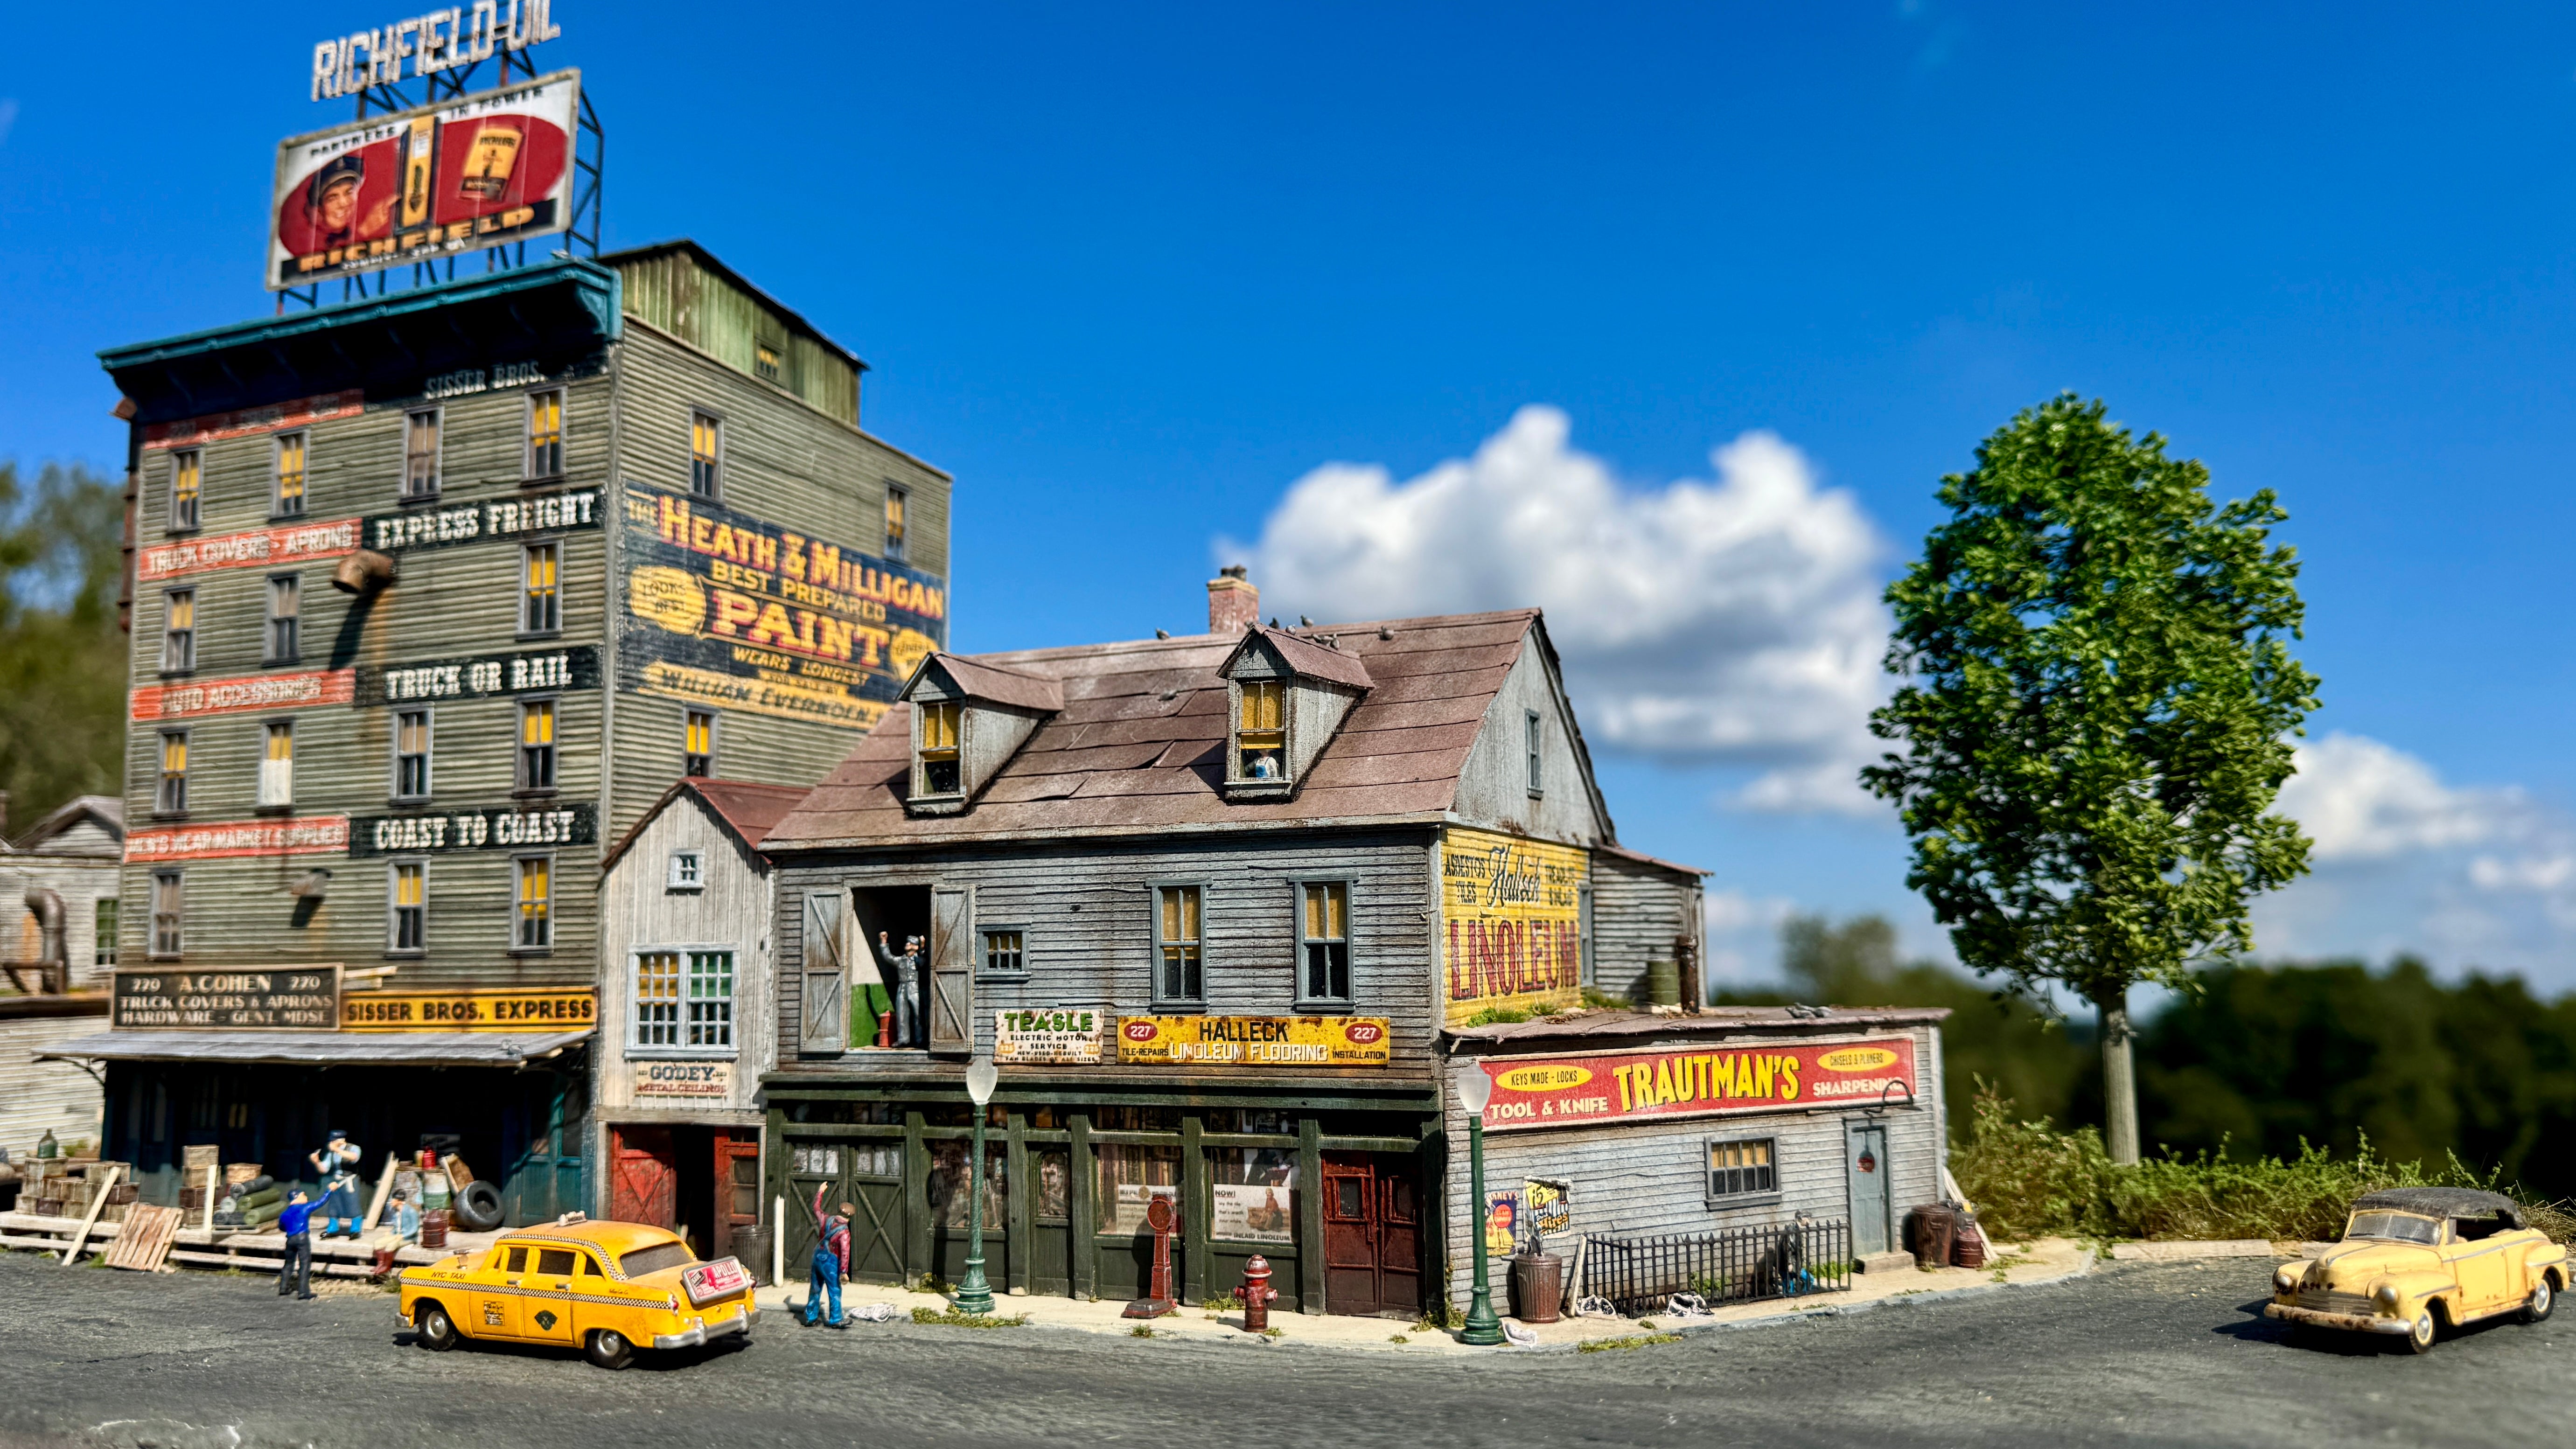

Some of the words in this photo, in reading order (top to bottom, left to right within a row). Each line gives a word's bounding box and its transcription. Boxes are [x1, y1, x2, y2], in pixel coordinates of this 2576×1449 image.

[312, 0, 497, 102] RICHFIELD
[310, 126, 396, 157] PARTNERS
[449, 107, 470, 120] IN
[480, 87, 544, 110] POWER
[298, 206, 535, 272] RICHFIELD
[423, 369, 487, 400] SISSER
[374, 508, 480, 550] EXPRESS
[488, 492, 595, 536] FREIGHT
[628, 497, 659, 528] THE
[147, 545, 198, 574] TRUCK
[202, 534, 271, 561] COVERS
[285, 523, 355, 555] APRONS
[658, 494, 778, 573] HEATH
[781, 531, 807, 583] &
[809, 539, 945, 621] MILLIGAN
[710, 559, 775, 592] BEST
[781, 576, 887, 624] PREPARED
[711, 588, 891, 668] PAINT
[384, 665, 461, 700] TRUCK
[468, 662, 503, 692] OR
[510, 655, 573, 690] RAIL
[733, 646, 793, 672] WEARS
[800, 659, 871, 686] LONGEST
[206, 675, 323, 710] ACCESSORIES
[211, 827, 272, 849] MARKET
[273, 823, 347, 847] SUPPLIES
[373, 816, 448, 850] COAST
[453, 814, 489, 847] TO
[495, 810, 575, 844] COAST
[1445, 853, 1486, 879] ASBESTOS
[1456, 880, 1477, 904] TILES
[1450, 918, 1577, 1001] LINOLEUM
[119, 995, 174, 1010] TRUCK
[178, 994, 245, 1011] COVERS
[265, 994, 334, 1009] APRONS
[347, 1001, 413, 1022] SISSER
[423, 1000, 485, 1021] BROS.
[495, 998, 593, 1020] EXPRESS
[119, 1010, 216, 1025] HARDWARE
[1004, 1012, 1093, 1032] TEASLE
[1130, 1025, 1150, 1038] 227
[1199, 1021, 1290, 1042] HALLECK
[1354, 1026, 1377, 1040] 227
[1169, 1043, 1246, 1060] LINOLEUM
[1250, 1044, 1329, 1062] FLOORING
[1332, 1050, 1386, 1060] INSTALLATION
[650, 1064, 716, 1081] GODEY
[1511, 1073, 1528, 1086] KEYS
[1530, 1071, 1549, 1085] MADE
[1557, 1070, 1578, 1083] LOCKS
[1613, 1053, 1801, 1113] TRAUTMAN'S
[1813, 1076, 1905, 1097] SHARPENING
[637, 1083, 676, 1093] METAL
[1490, 1103, 1536, 1119] TOOL
[1542, 1101, 1554, 1115] &
[1560, 1097, 1609, 1115] KNIFE
[1539, 1211, 1568, 1228] Hires
[712, 1261, 738, 1279] APOLLO
